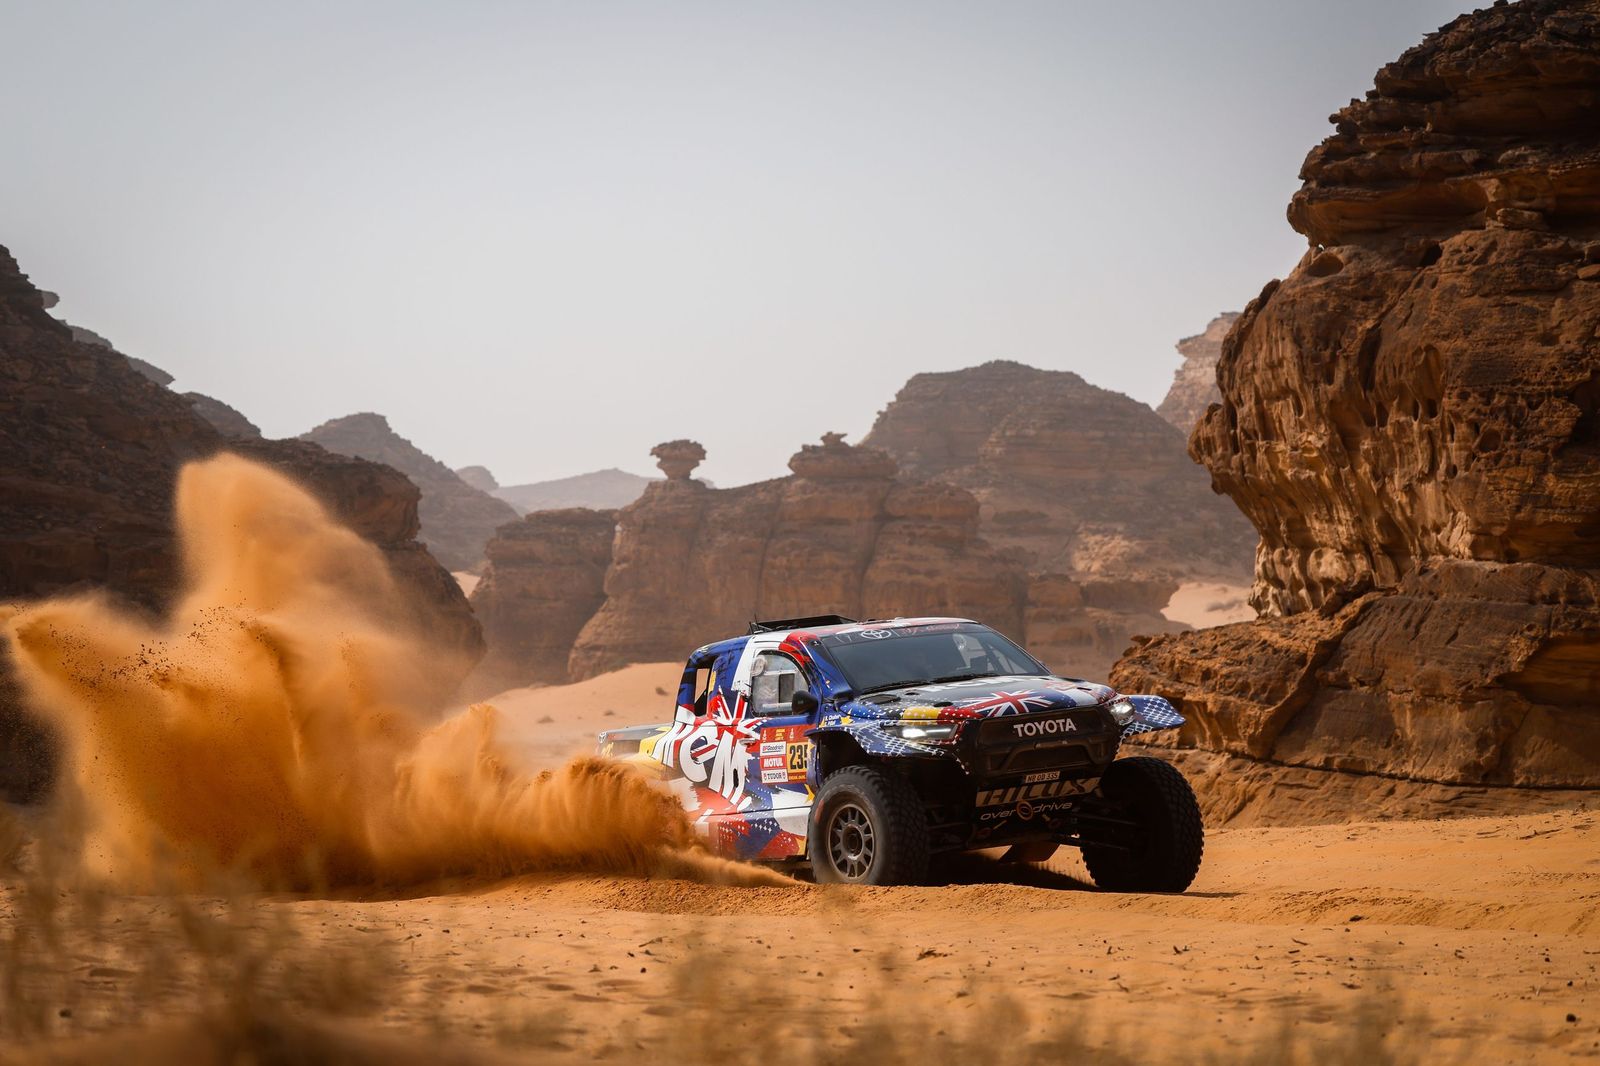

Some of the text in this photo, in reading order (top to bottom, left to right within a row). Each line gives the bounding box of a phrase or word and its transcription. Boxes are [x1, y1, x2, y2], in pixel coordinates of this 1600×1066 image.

[1013, 718, 1077, 738] TOYOTA
[762, 745, 784, 753] BFGoodrich
[763, 757, 784, 768] MOTUL
